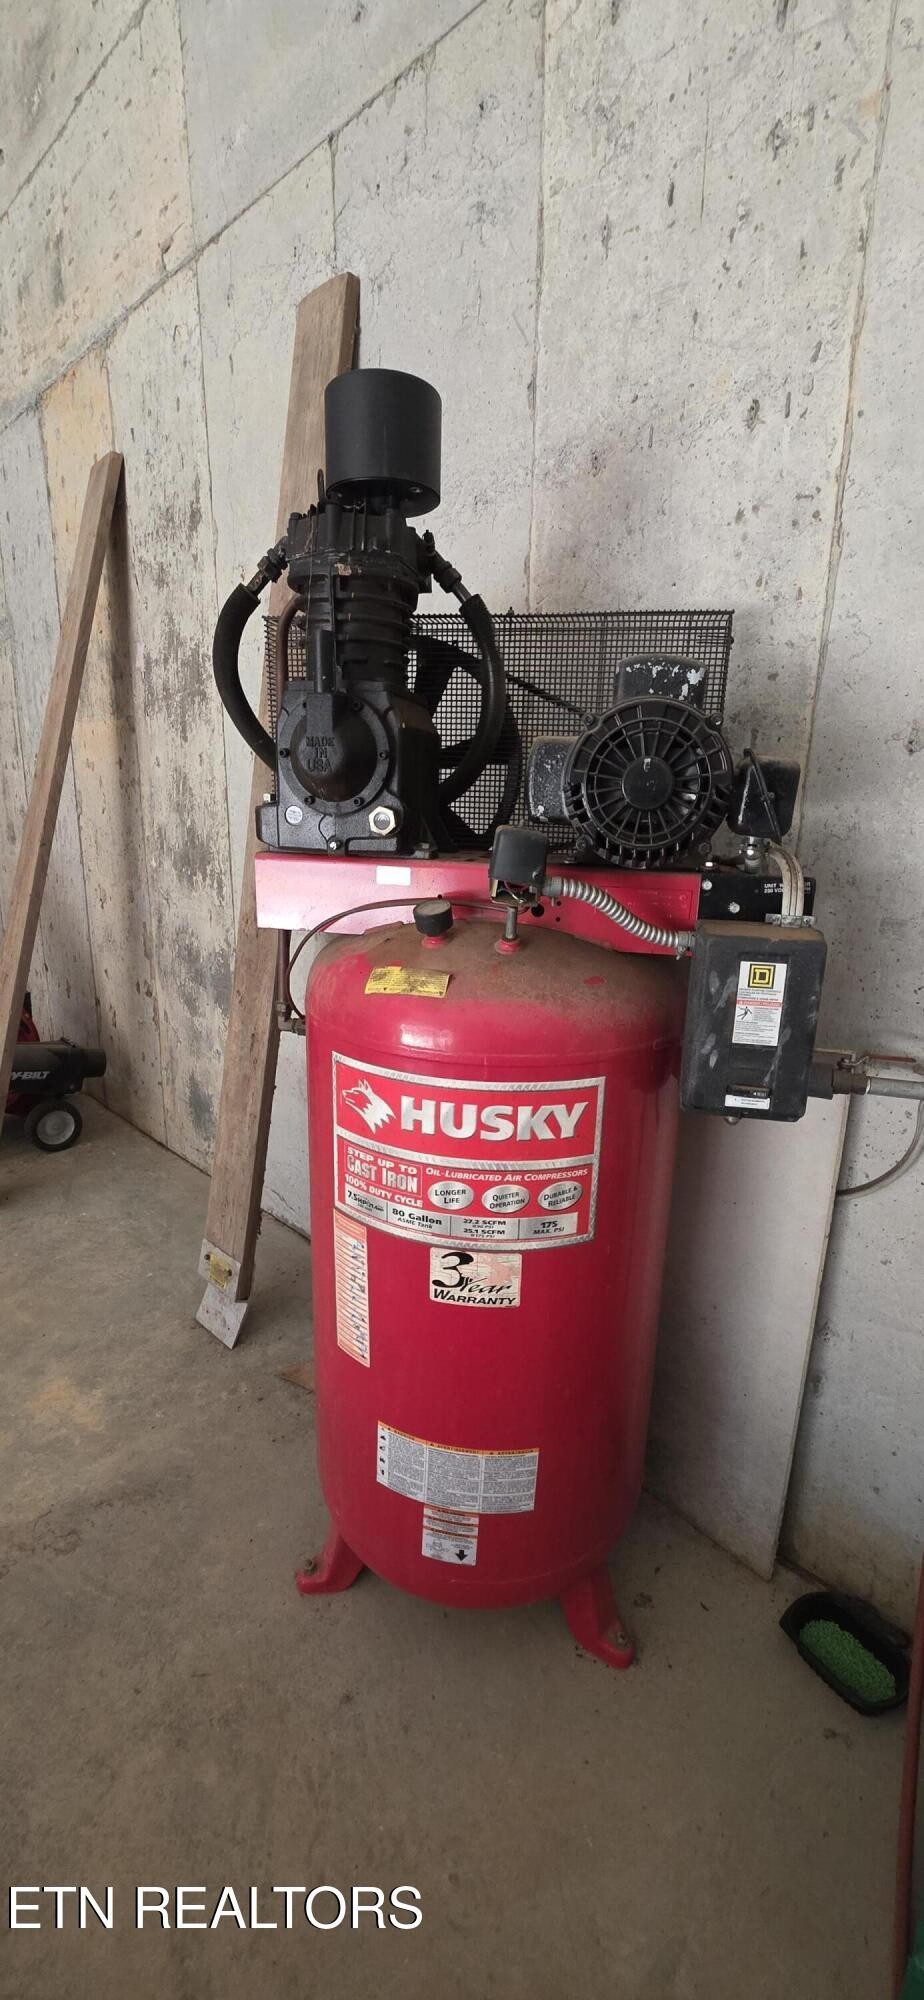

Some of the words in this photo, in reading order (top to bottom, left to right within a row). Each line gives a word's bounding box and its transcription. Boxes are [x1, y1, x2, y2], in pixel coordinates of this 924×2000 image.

[306, 735, 335, 746] MADE
[315, 747, 328, 758] IN
[307, 759, 333, 772] USA
[12, 1071, 50, 1080] Y-BILT
[400, 1095, 589, 1142] HUSKY
[347, 1146, 374, 1162] STEP
[378, 1158, 395, 1168] UP
[399, 1164, 418, 1174] TO
[347, 1154, 377, 1181] CAST
[382, 1168, 418, 1193] IRON
[426, 1168, 502, 1182] OIL-LUBRICATED
[504, 1173, 522, 1182] AIR
[524, 1168, 588, 1182] COMPRESSORS
[345, 1174, 368, 1190] 100%
[369, 1186, 392, 1200] DUTY
[394, 1194, 423, 1208] CYCLE
[434, 1188, 467, 1196] LONGER
[492, 1192, 520, 1202] QUIETER
[544, 1188, 572, 1200] DURABLE
[490, 1198, 525, 1210] OPERATION
[548, 1194, 576, 1208] RELIABLE
[392, 1208, 406, 1217] 80
[408, 1213, 442, 1225] Gallon
[541, 1220, 558, 1228] 175
[432, 1252, 474, 1288] 3
[460, 1276, 512, 1294] Year
[434, 1288, 516, 1305] WARRANTY
